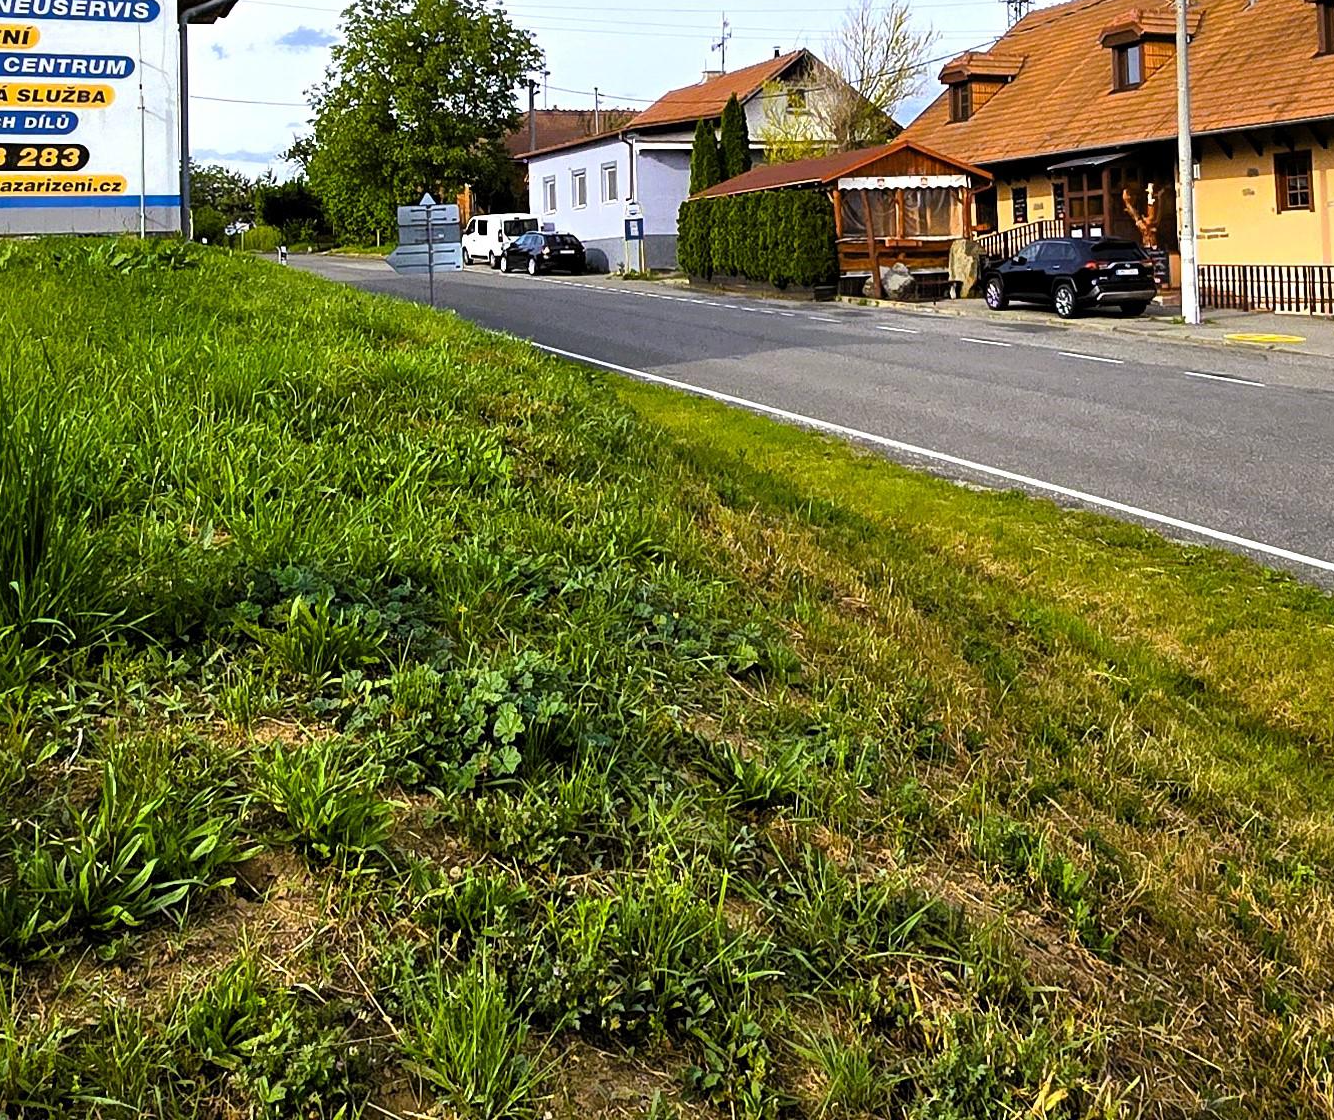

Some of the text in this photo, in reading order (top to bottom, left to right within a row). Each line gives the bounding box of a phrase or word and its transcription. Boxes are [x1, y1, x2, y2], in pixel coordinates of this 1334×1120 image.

[3, 56, 127, 75] CENTRUM
[17, 86, 107, 104] SLUŽBA
[24, 114, 70, 130] DÍLŮ
[17, 147, 81, 167] 283
